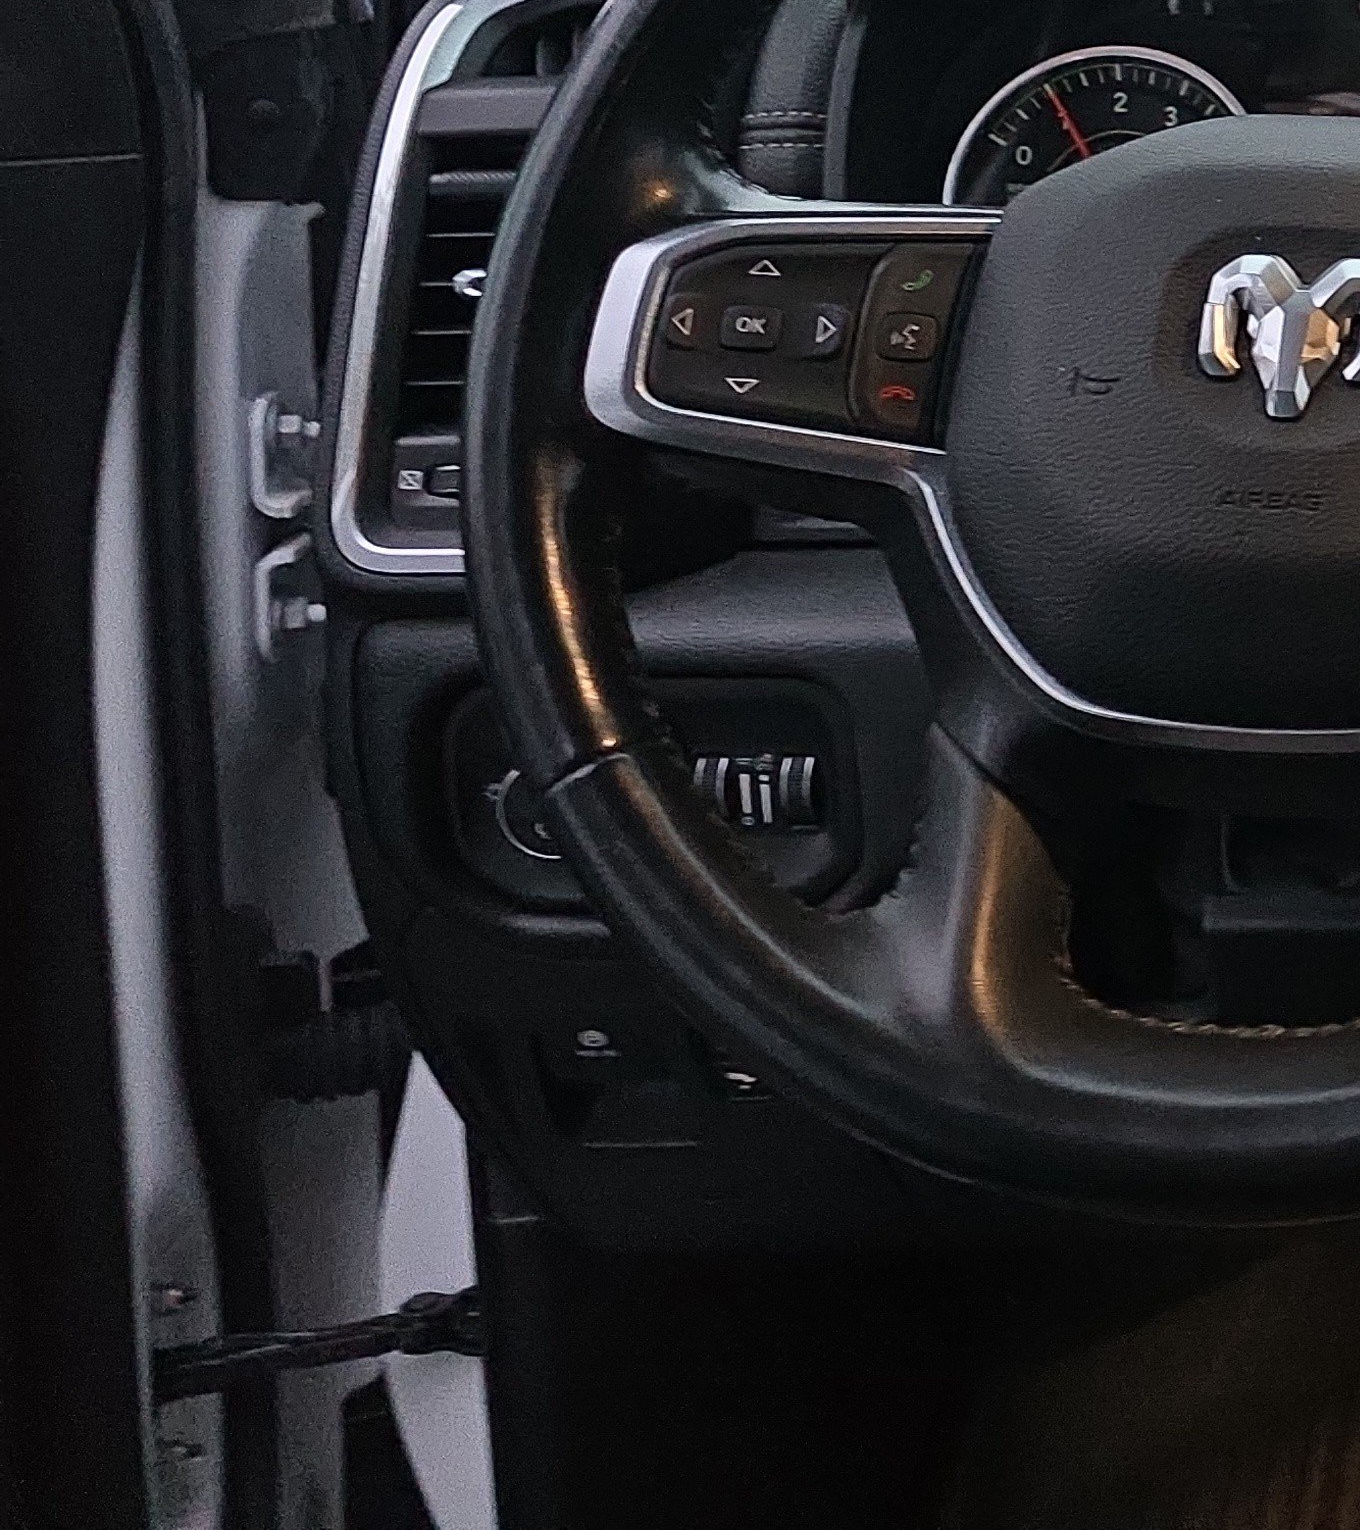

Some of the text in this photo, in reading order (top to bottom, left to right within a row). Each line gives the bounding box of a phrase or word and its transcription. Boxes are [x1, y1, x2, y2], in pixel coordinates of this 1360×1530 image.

[1112, 91, 1128, 113] 2
[1163, 105, 1178, 127] 3
[1014, 145, 1033, 166] 0
[735, 316, 766, 334] OK
